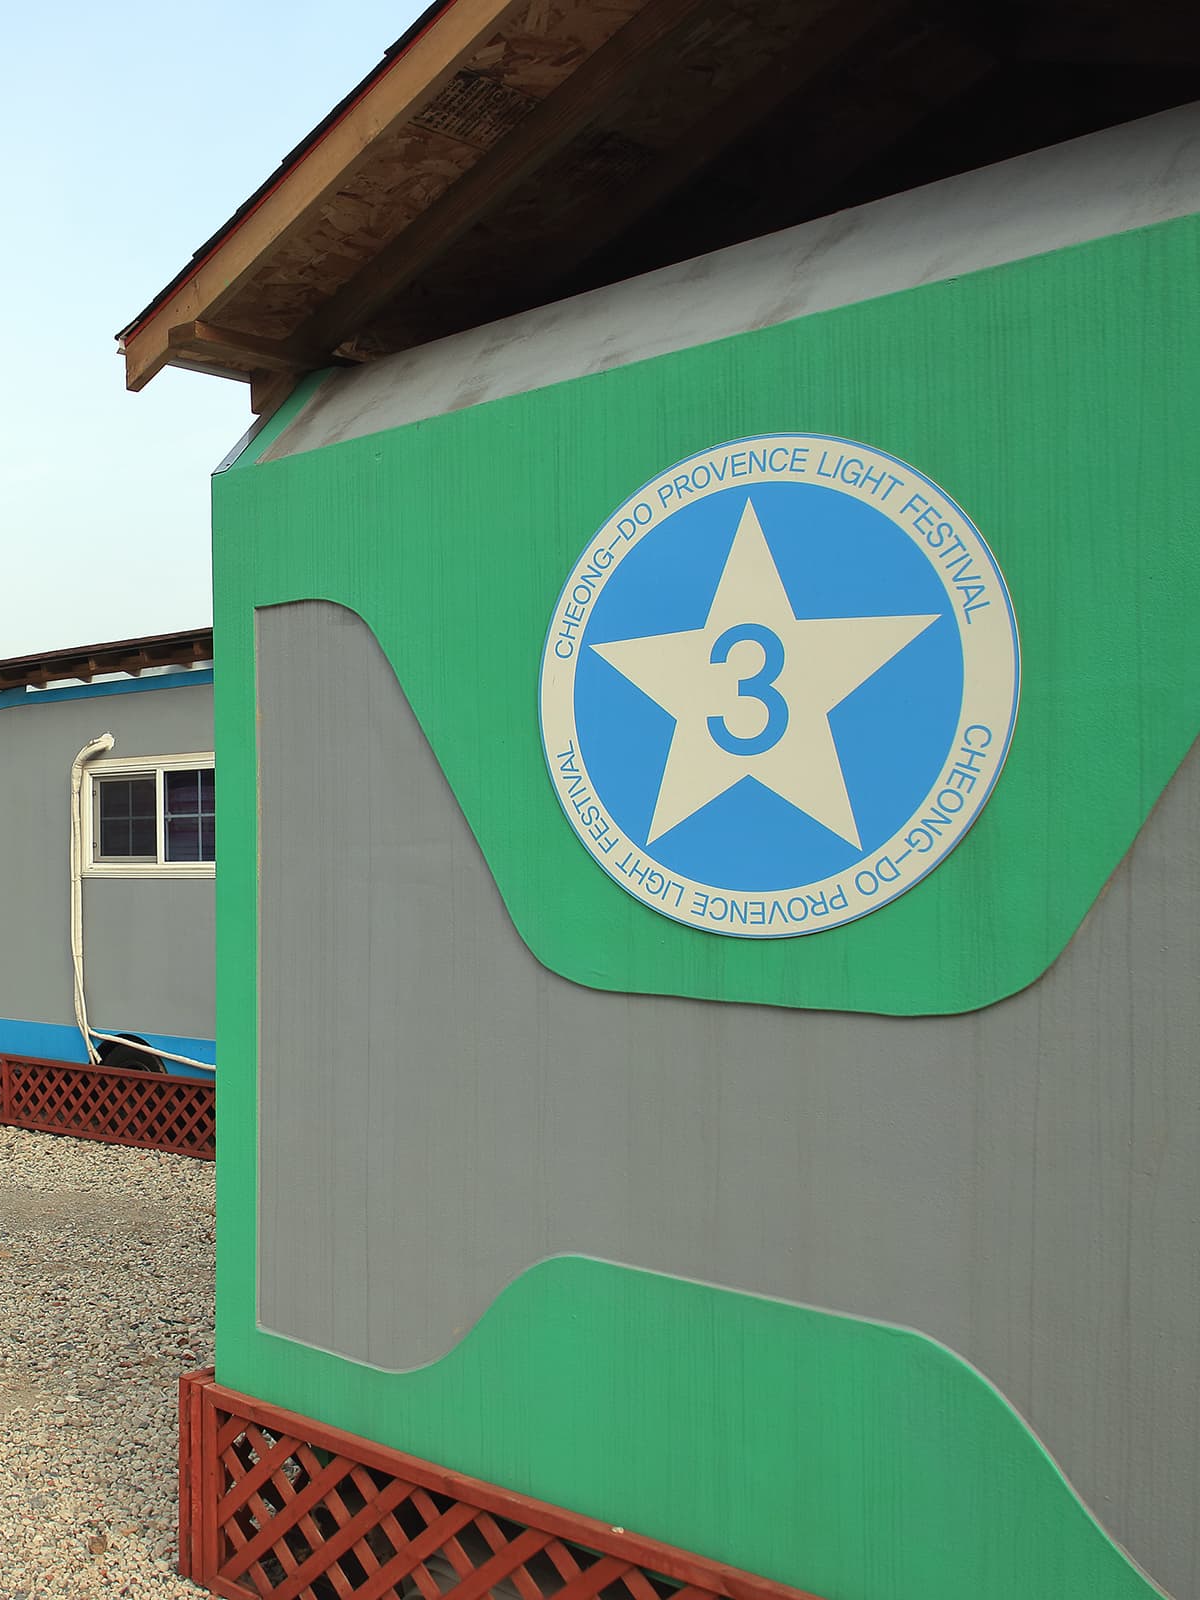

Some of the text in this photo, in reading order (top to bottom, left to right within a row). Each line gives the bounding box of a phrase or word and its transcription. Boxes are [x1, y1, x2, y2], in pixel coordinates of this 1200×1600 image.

[554, 447, 992, 660] CHEONG-DO PROVENCE LIGHT FESTIVAL
[706, 622, 790, 757] 3
[557, 723, 993, 926] CHEONG-DO PROVENCE LIGHT FESTIVAL
